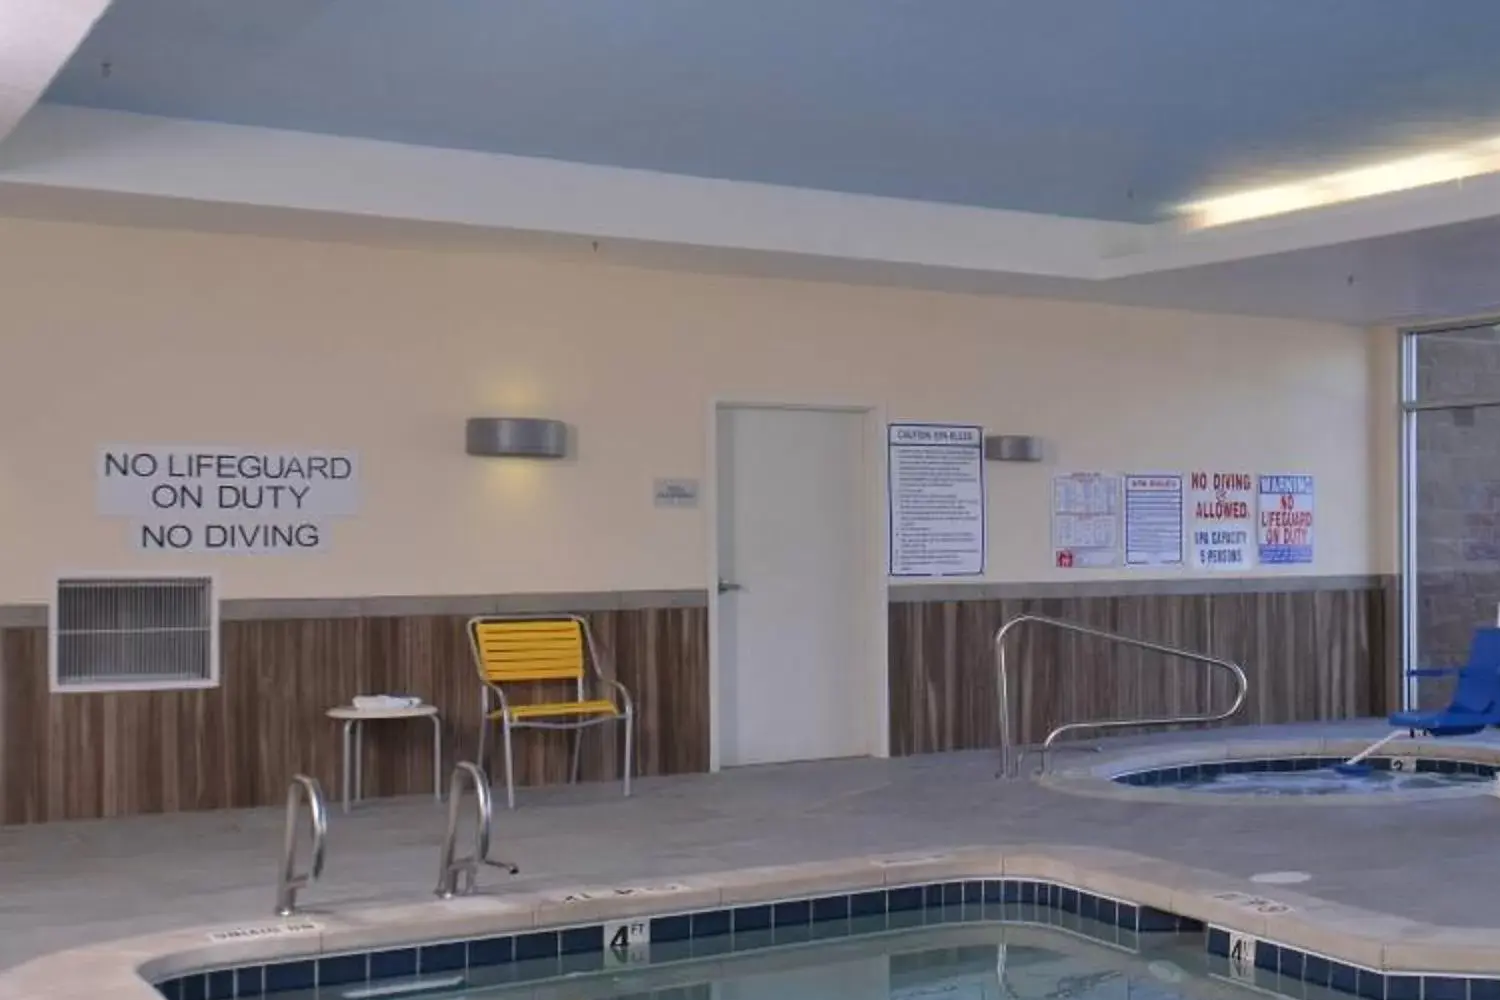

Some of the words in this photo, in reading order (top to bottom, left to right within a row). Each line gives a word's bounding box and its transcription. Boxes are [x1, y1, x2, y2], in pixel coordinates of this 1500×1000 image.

[105, 453, 158, 477] NO
[168, 454, 352, 479] LIFEGUARD
[1191, 472, 1207, 490] NO
[1213, 473, 1252, 491] DIVING
[151, 484, 203, 509] ON
[218, 485, 311, 509] DUTY
[1261, 511, 1312, 528] LIFEGUARD
[141, 524, 194, 548] NO
[205, 524, 320, 548] DIVING
[609, 925, 629, 947] 4
